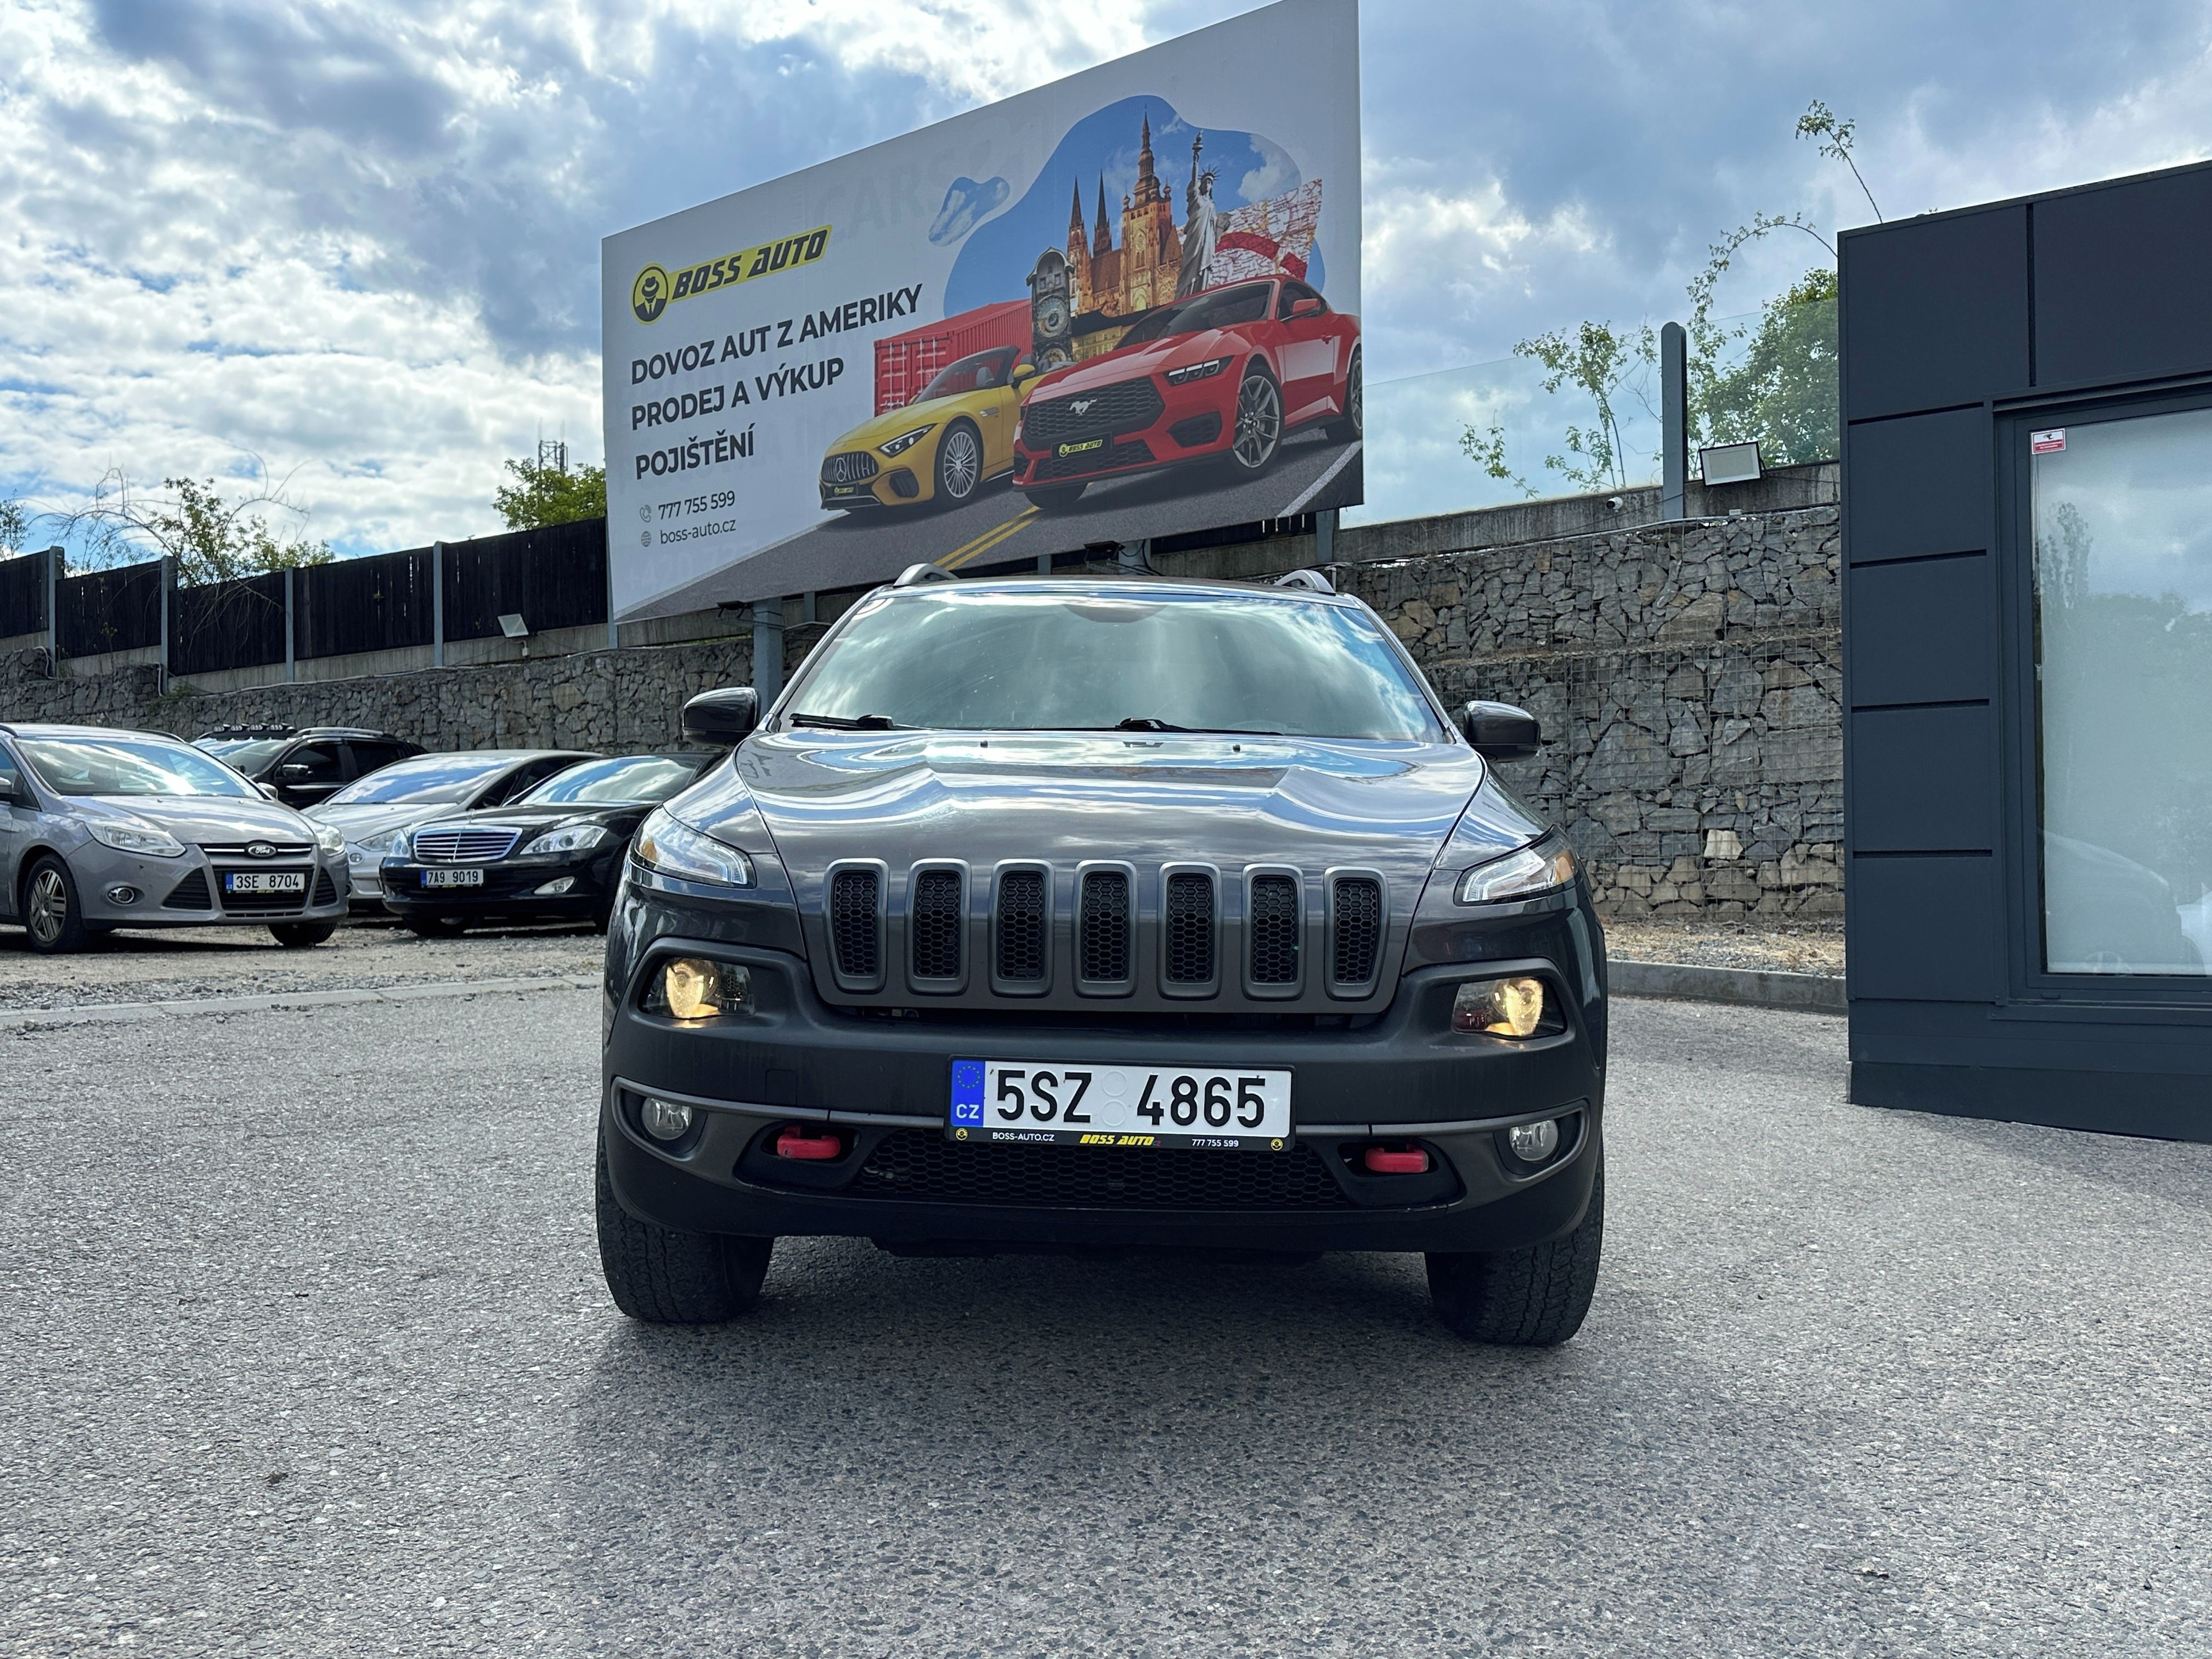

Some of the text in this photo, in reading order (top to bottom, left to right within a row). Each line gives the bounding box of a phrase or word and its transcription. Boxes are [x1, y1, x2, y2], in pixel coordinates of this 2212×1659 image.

[672, 229, 827, 300] BOSS AUTO
[632, 284, 923, 385] DOVOZ AUT Z AMERIKY
[632, 357, 844, 431] PRODEJ A VÝKUP
[636, 423, 756, 479] POJIŠTĚNÍ
[658, 490, 735, 520] 777 755 599
[660, 520, 736, 544] boss-auto.cz
[236, 875, 259, 888] 3SE
[269, 875, 299, 888] 8704
[428, 871, 478, 883] 7A9 9019
[956, 1069, 1266, 1128] CZ 5SZ 4865
[992, 1132, 1054, 1142] BOSS-AUTO.CZ
[1080, 1134, 1115, 1144] BOSS
[1116, 1136, 1155, 1146] AUTO
